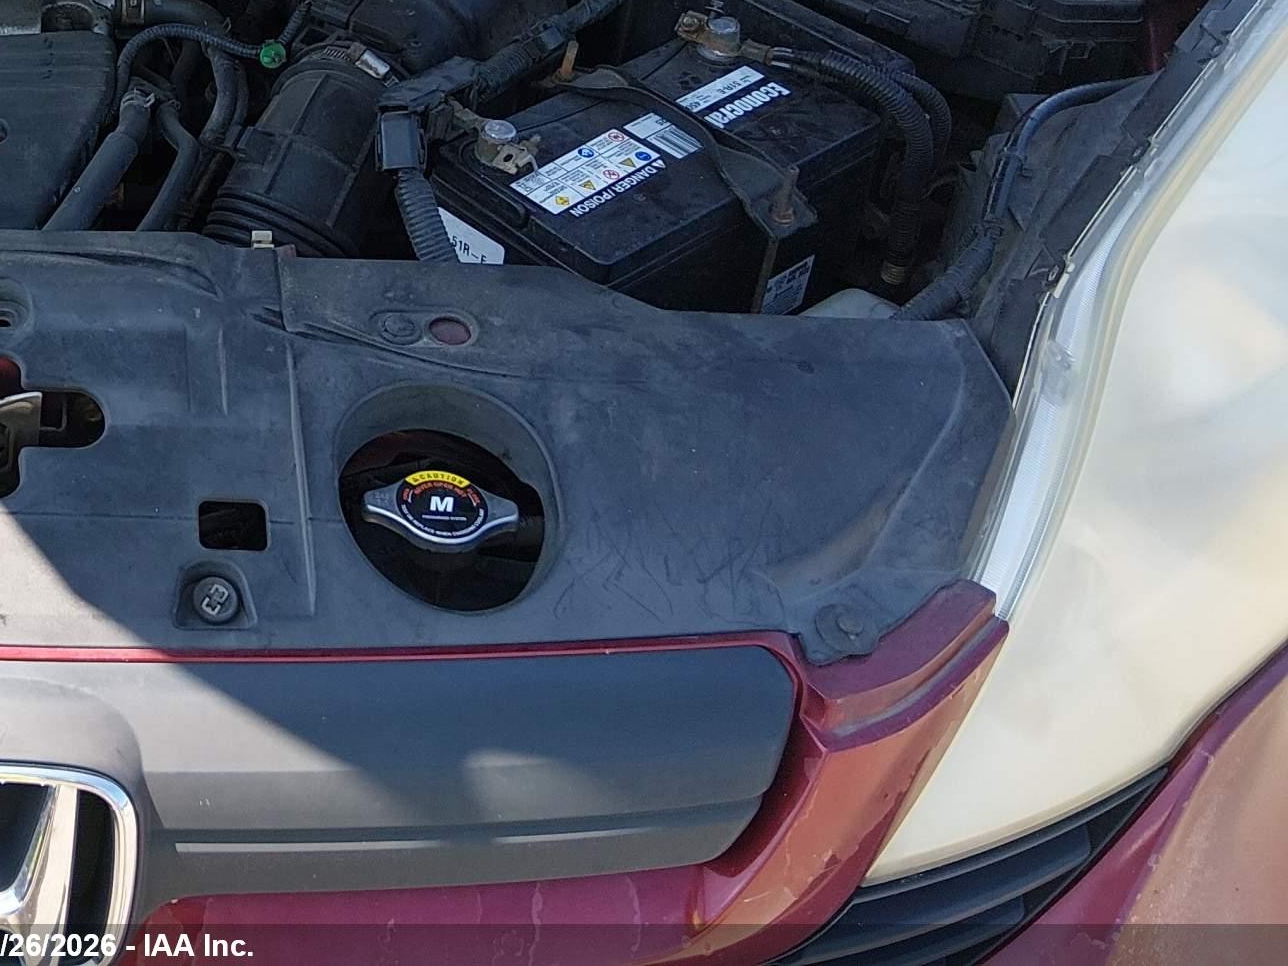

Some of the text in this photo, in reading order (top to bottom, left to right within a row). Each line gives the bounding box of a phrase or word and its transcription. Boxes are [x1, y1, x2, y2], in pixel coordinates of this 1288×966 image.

[614, 166, 658, 194] DANGER
[419, 473, 465, 486] CAUTION
[430, 496, 454, 512] M
